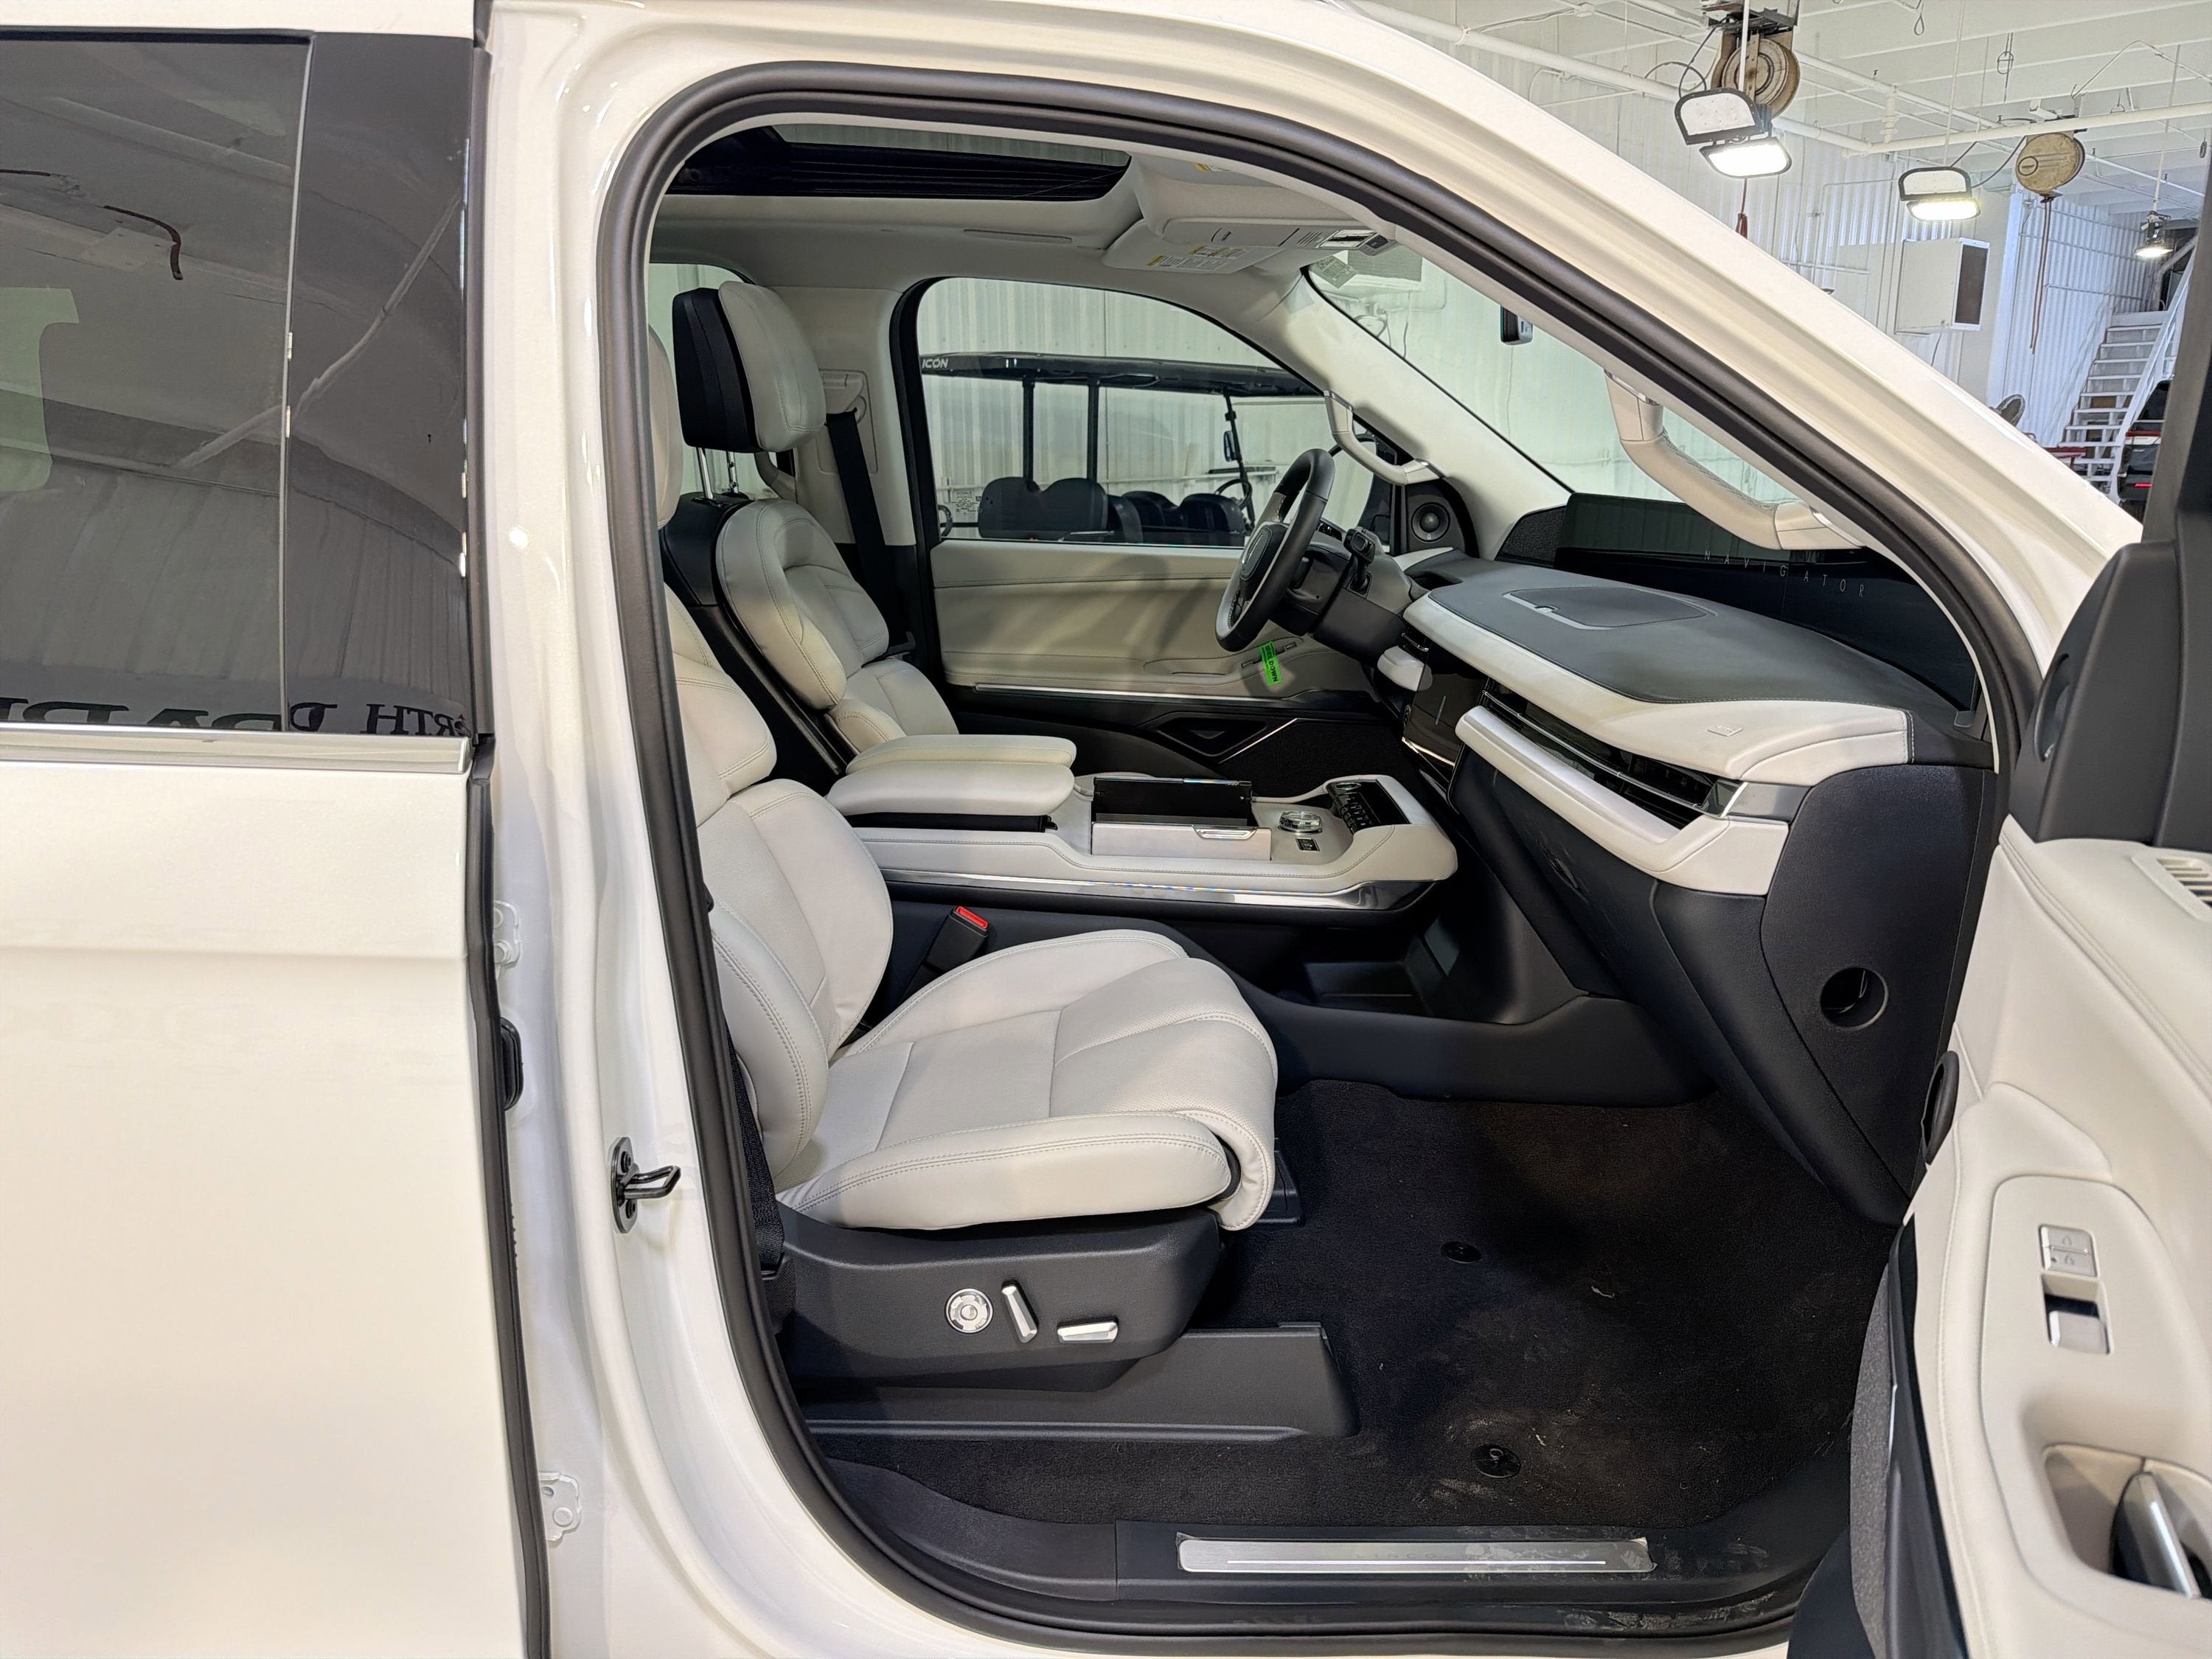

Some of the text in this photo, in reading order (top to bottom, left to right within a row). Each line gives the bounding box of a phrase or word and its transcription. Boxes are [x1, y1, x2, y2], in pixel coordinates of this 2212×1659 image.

[922, 358, 949, 369] ICON
[1704, 550, 1865, 597] NAVIGATOR
[1268, 660, 1279, 682] DOWN
